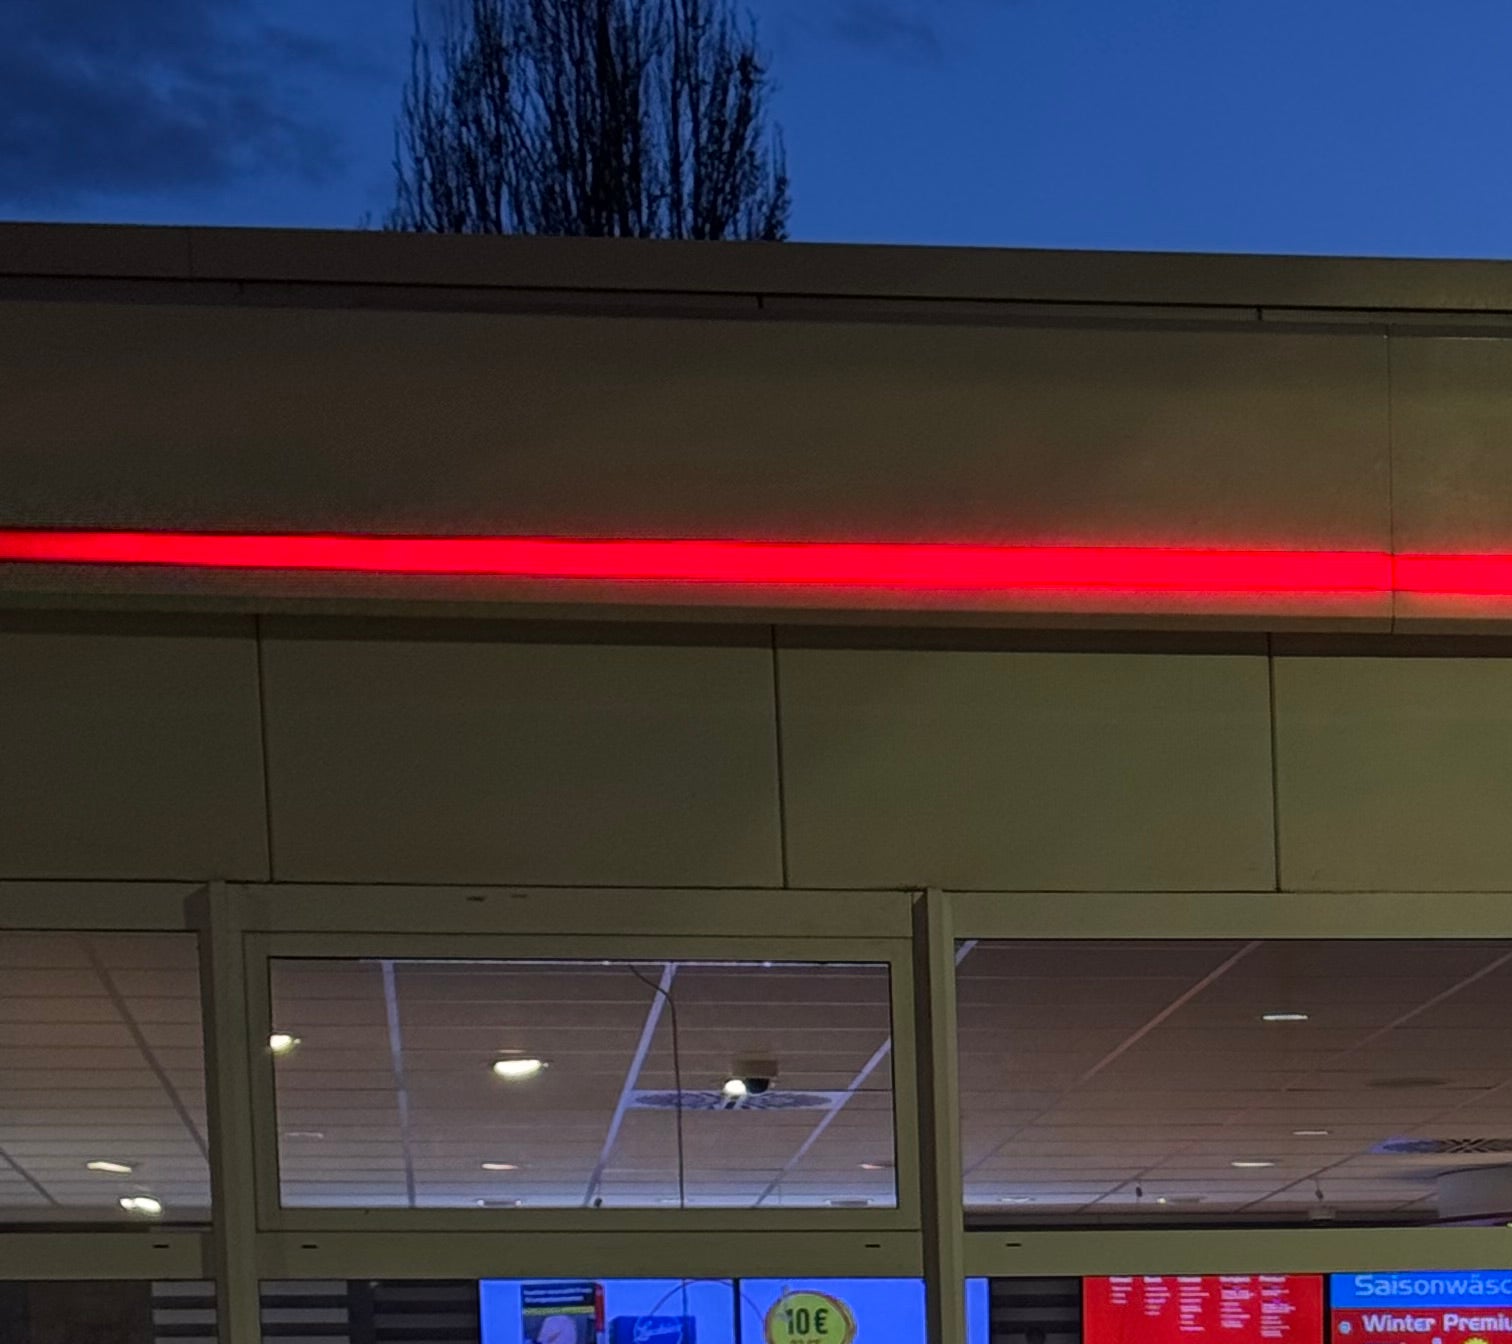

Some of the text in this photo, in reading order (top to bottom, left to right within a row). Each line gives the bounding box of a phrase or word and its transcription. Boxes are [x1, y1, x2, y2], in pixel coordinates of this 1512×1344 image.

[786, 1307, 829, 1335] 10 €
[1361, 1313, 1436, 1333] Winter
